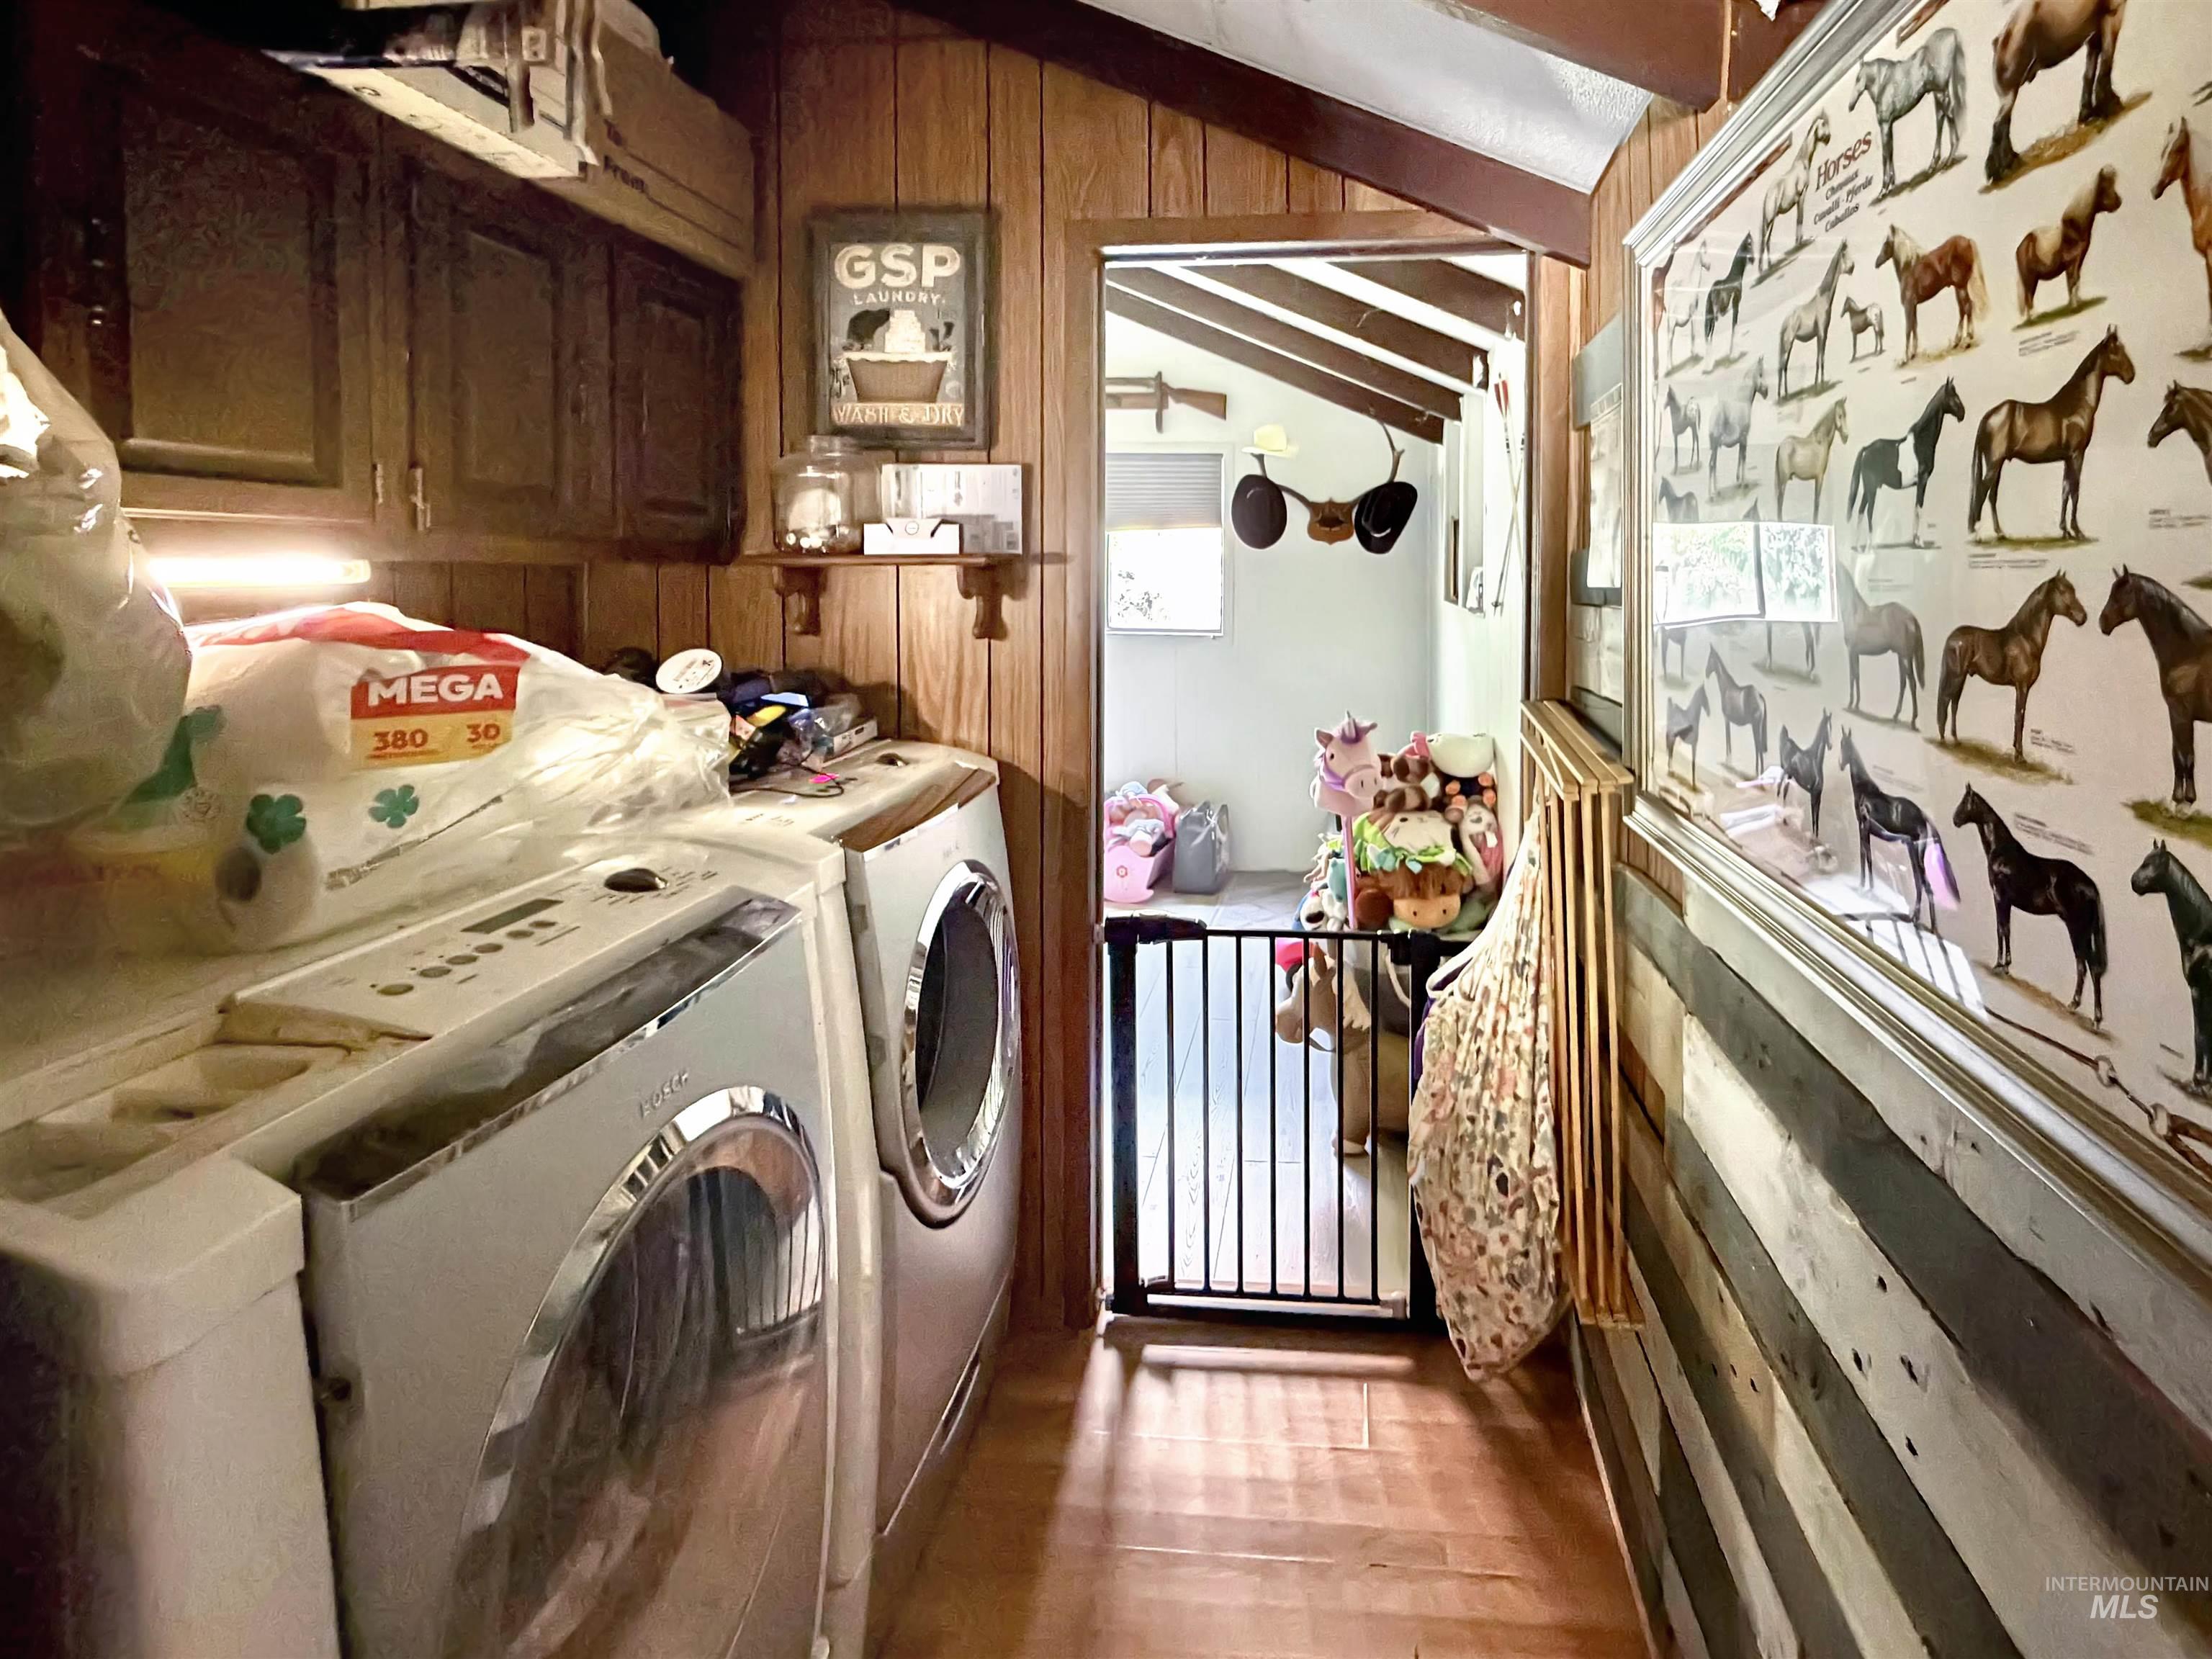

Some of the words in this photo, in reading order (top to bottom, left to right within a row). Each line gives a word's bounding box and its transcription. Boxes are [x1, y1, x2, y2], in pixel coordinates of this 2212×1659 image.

[1815, 131, 1872, 193] Horses
[835, 243, 961, 289] GSP
[832, 404, 889, 424] WASH
[899, 407, 915, 424] &
[922, 403, 963, 427] DRY
[367, 673, 503, 706] MEGA
[373, 728, 428, 752] 380
[466, 723, 500, 743] 30
